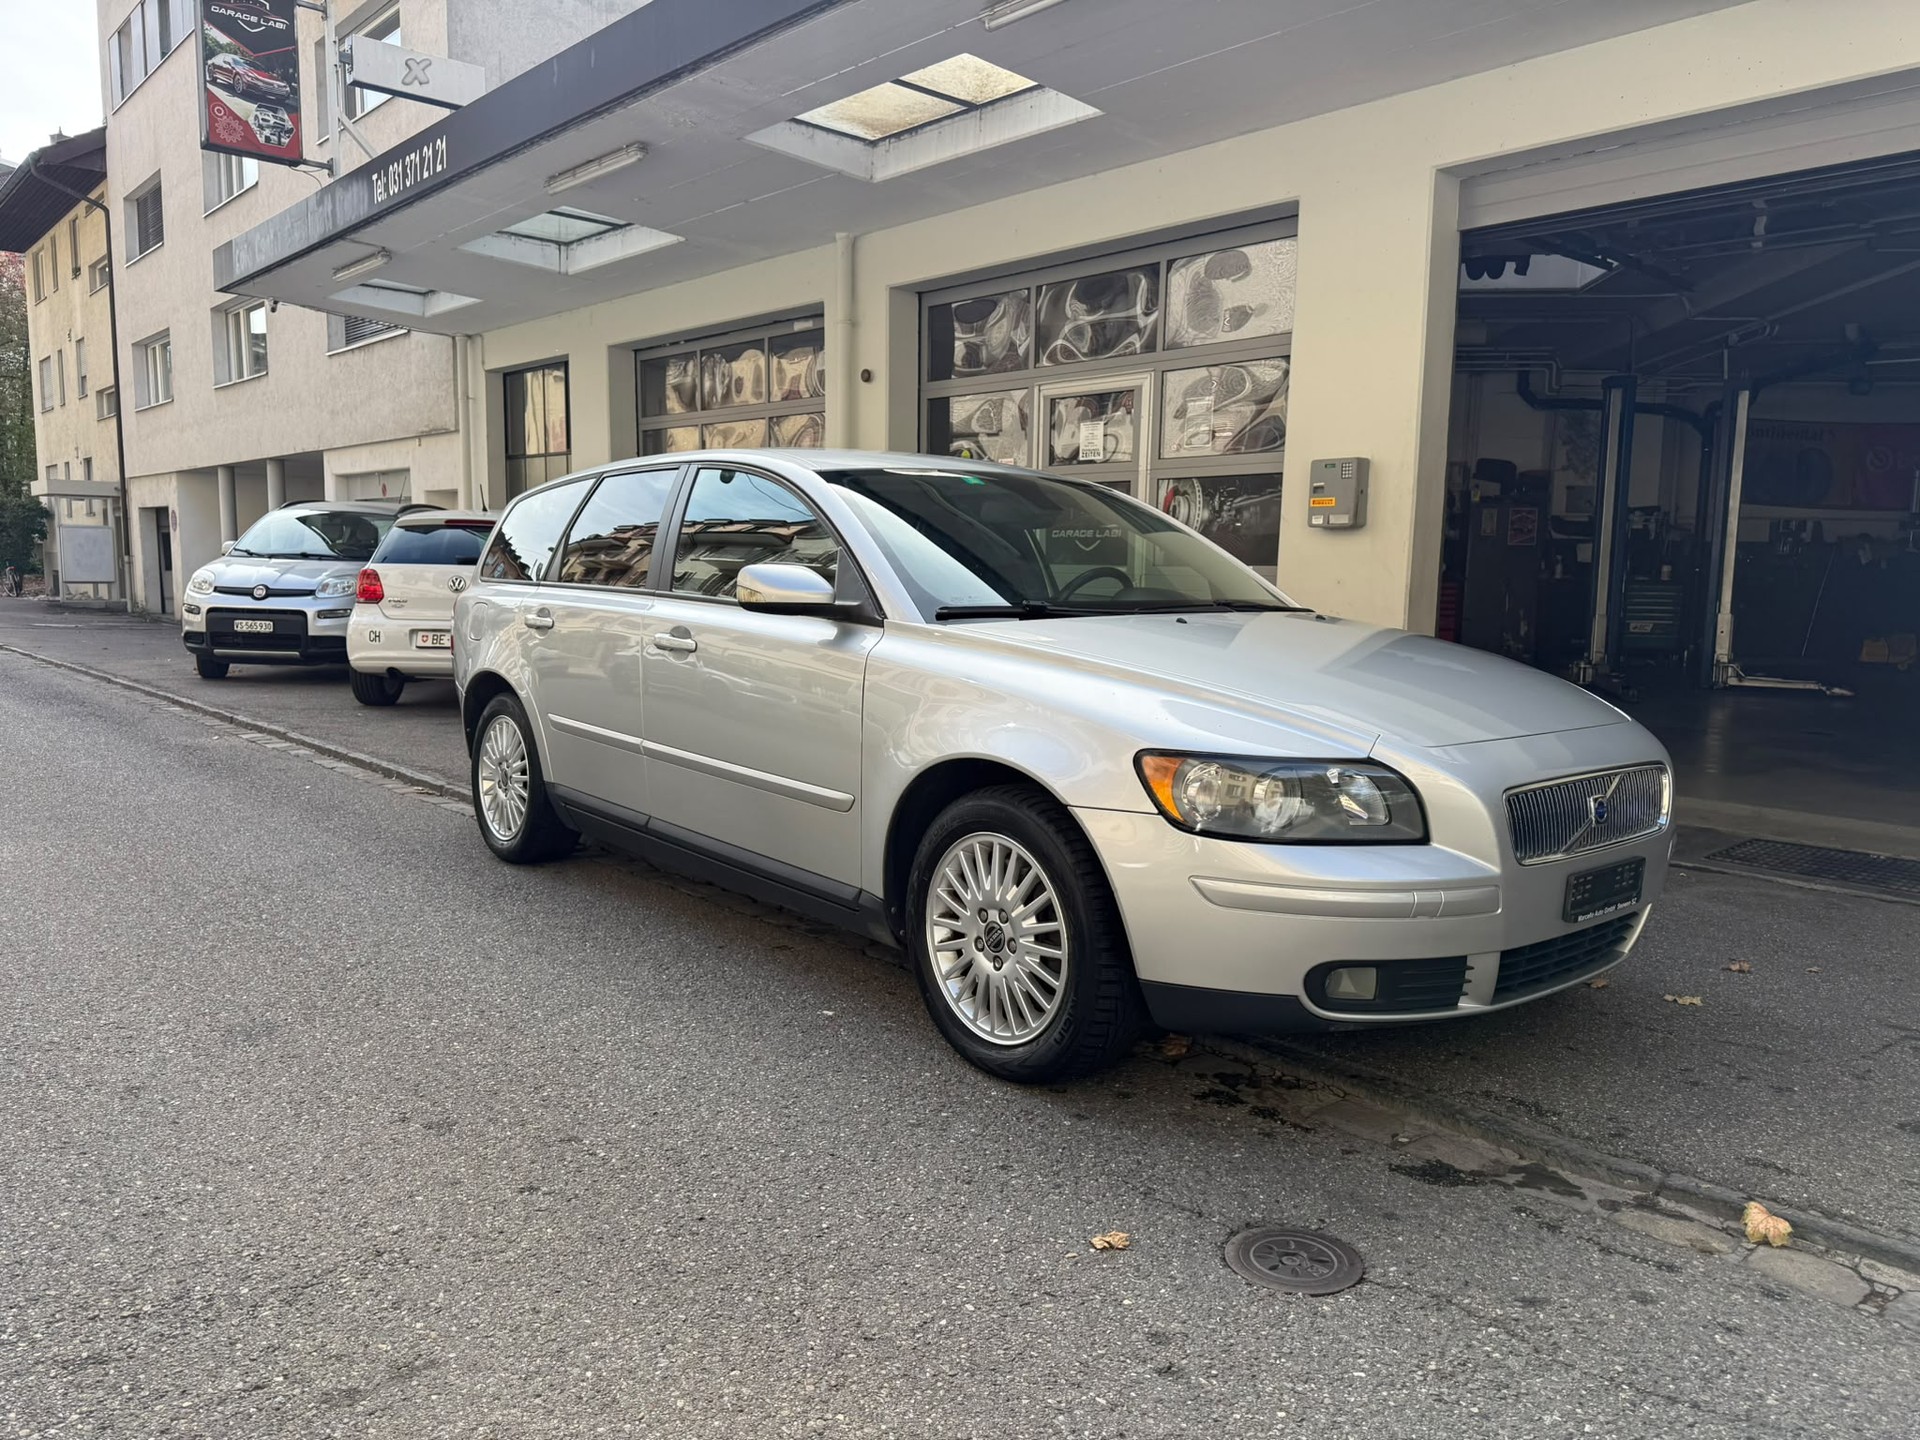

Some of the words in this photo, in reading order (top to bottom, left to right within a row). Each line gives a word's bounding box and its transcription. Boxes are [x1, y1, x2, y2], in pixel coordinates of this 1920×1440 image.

[211, 5, 258, 22] GARAGE
[260, 18, 287, 30] LABI
[372, 169, 387, 204] Tel:
[388, 158, 403, 196] 031
[405, 149, 420, 188] 371
[422, 142, 433, 179] 21
[435, 134, 447, 173] 21
[1051, 529, 1094, 538] GARAGE
[368, 630, 381, 643] CH
